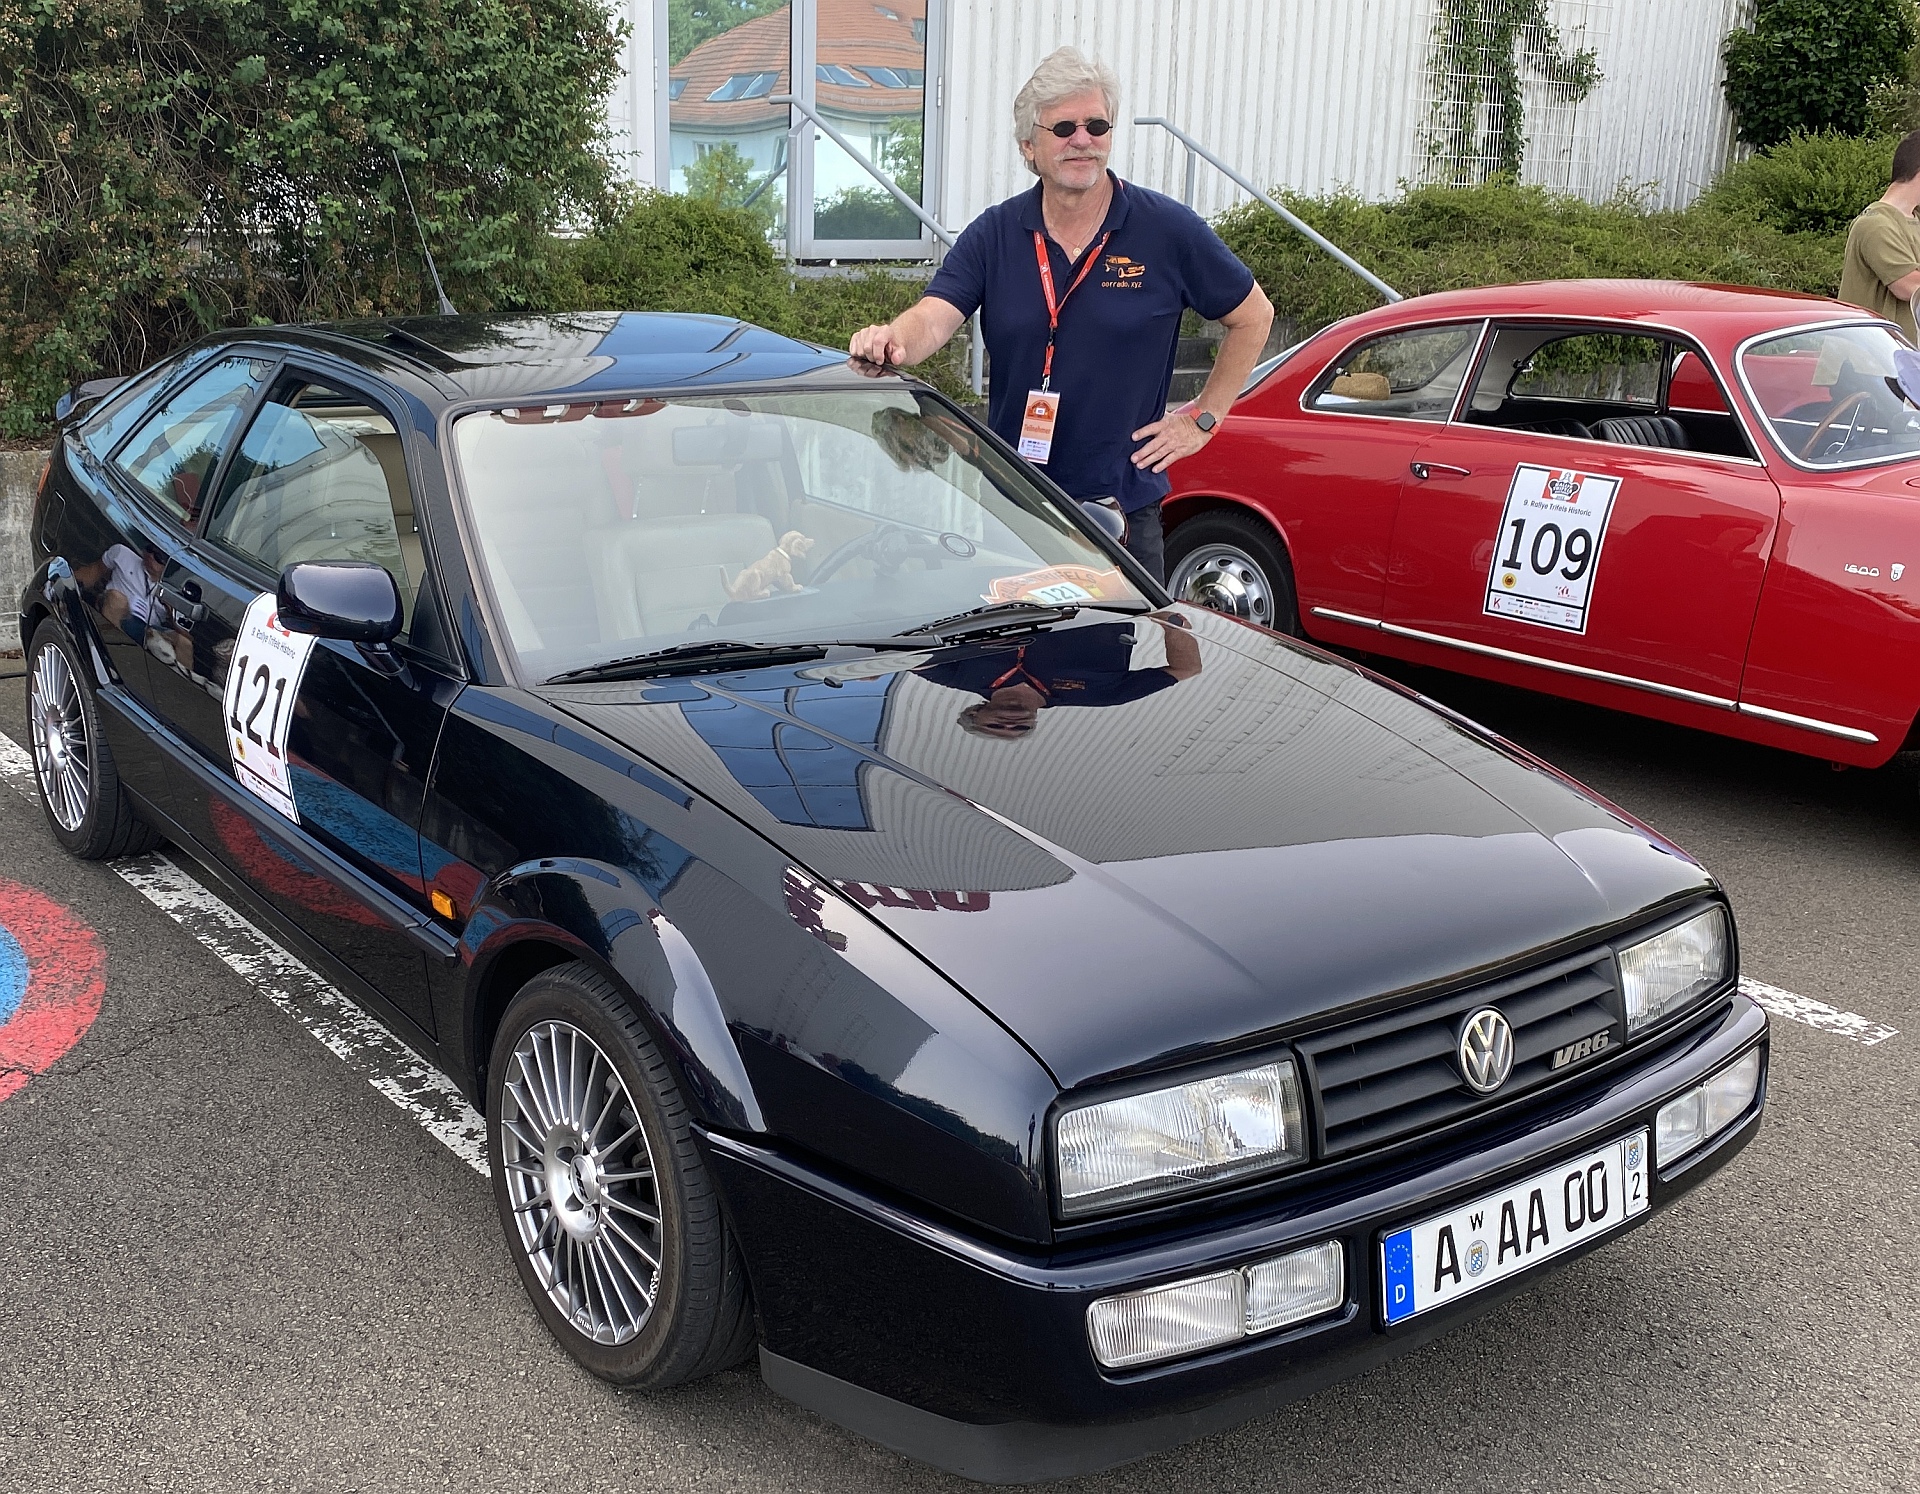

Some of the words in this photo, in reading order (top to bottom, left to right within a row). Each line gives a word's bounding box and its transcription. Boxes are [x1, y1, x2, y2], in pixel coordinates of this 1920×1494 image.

[1530, 500, 1549, 511] Rallye
[1549, 503, 1568, 513] Trifels
[1568, 506, 1592, 517] Historic
[1502, 518, 1592, 581] 109
[1041, 585, 1083, 603] 121
[230, 655, 286, 760] 121
[1550, 1029, 1610, 1070] VR6
[1632, 1171, 1641, 1201] 2
[1469, 1210, 1484, 1232] W
[1433, 1224, 1462, 1293] A
[1497, 1187, 1550, 1266] AA
[1395, 1283, 1406, 1304] D
